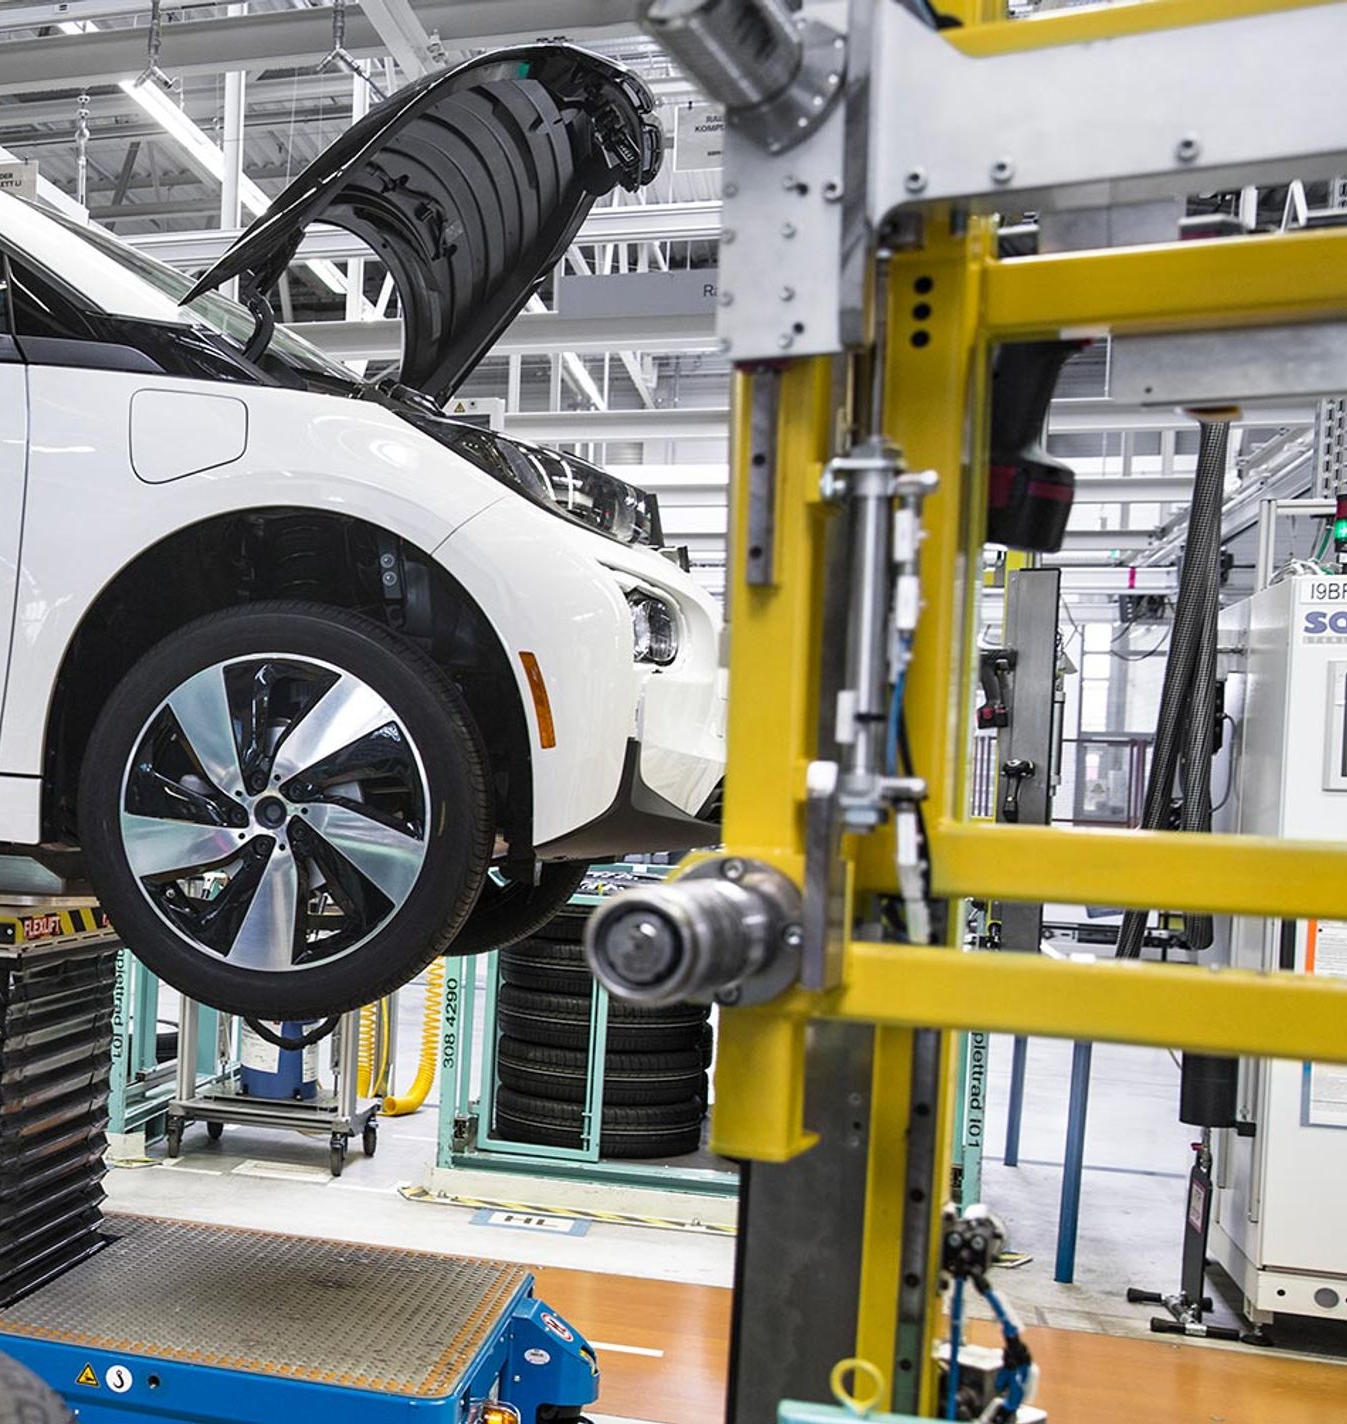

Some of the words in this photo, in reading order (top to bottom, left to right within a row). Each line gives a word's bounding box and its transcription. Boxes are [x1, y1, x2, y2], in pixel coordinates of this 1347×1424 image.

[24, 916, 60, 938] FLEXLIFT
[445, 978, 458, 1027] 4290
[443, 1032, 456, 1068] 308
